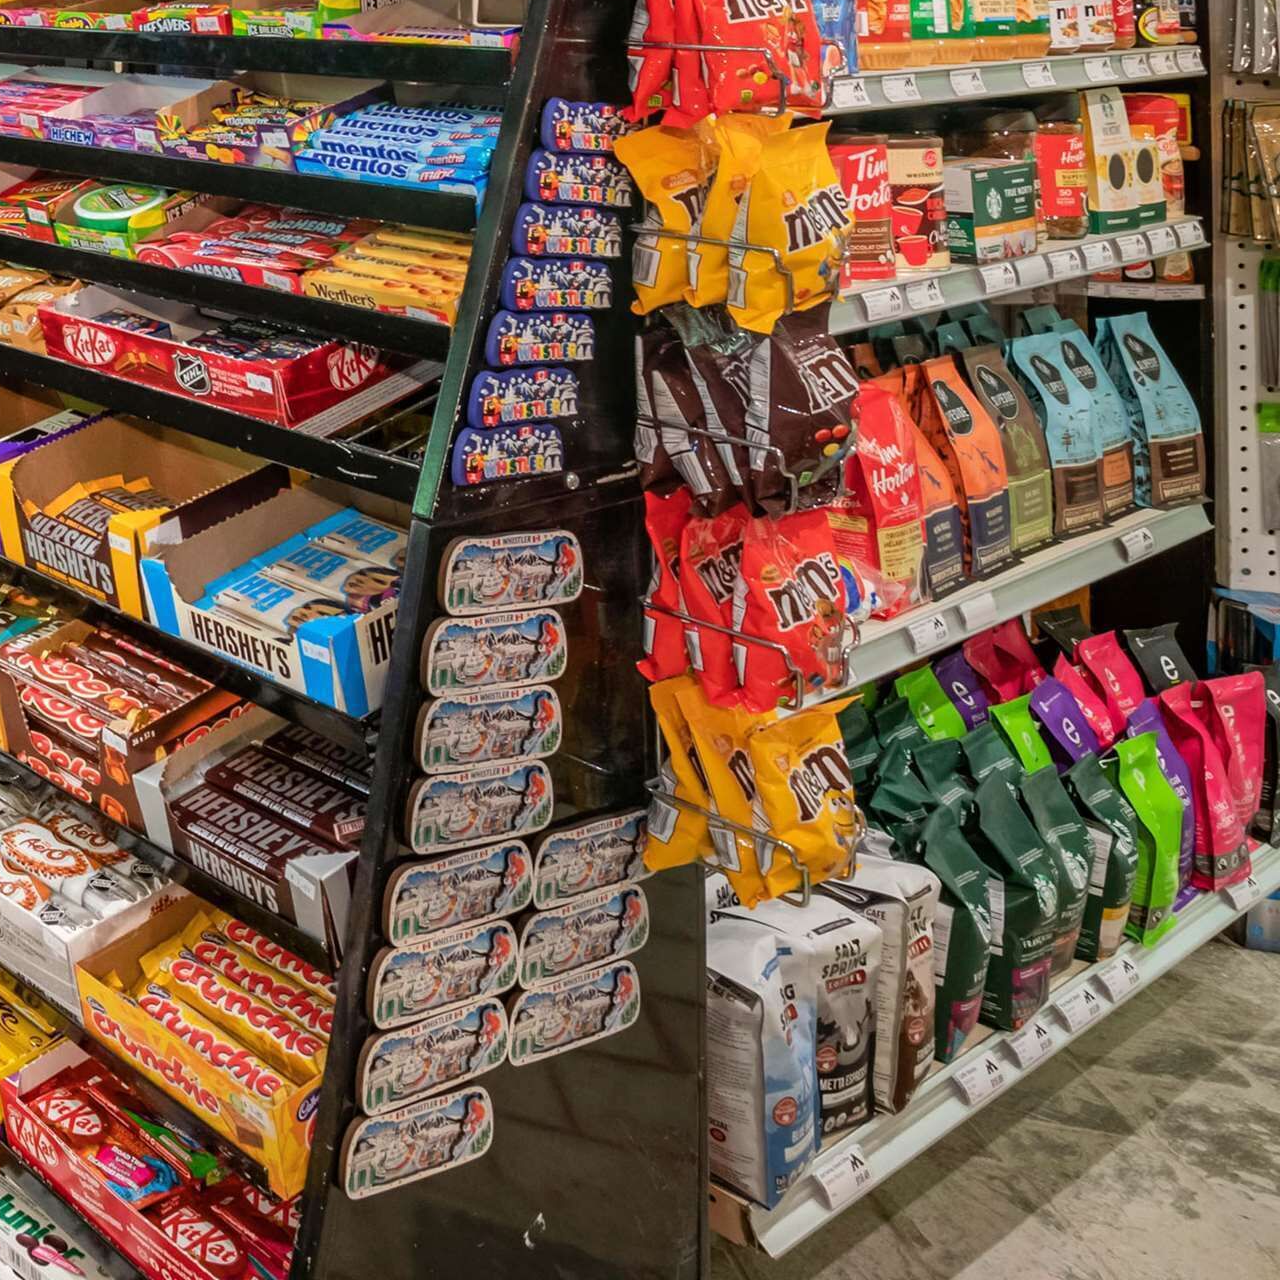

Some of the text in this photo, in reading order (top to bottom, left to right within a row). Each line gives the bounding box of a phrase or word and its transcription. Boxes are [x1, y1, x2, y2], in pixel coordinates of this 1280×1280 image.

[51, 127, 94, 144] HI-CHEW
[320, 139, 418, 162] mentos
[426, 152, 466, 164] menthe
[848, 148, 888, 182] Tim
[265, 219, 345, 236] AIRHEADS
[782, 184, 850, 253] m&m's
[547, 235, 605, 255] WHISTLER
[311, 281, 376, 311] Werther's
[535, 290, 595, 308] WHISTLER
[68, 330, 113, 362] KitKat
[27, 529, 114, 594] HERSHEY'S
[285, 547, 342, 580] HER
[191, 610, 291, 677] HERSHEY'S
[189, 839, 279, 914] HERSHEY'S
[835, 939, 862, 961] SALT
[821, 954, 868, 981] SPRING
[161, 1206, 238, 1266] KitKat
